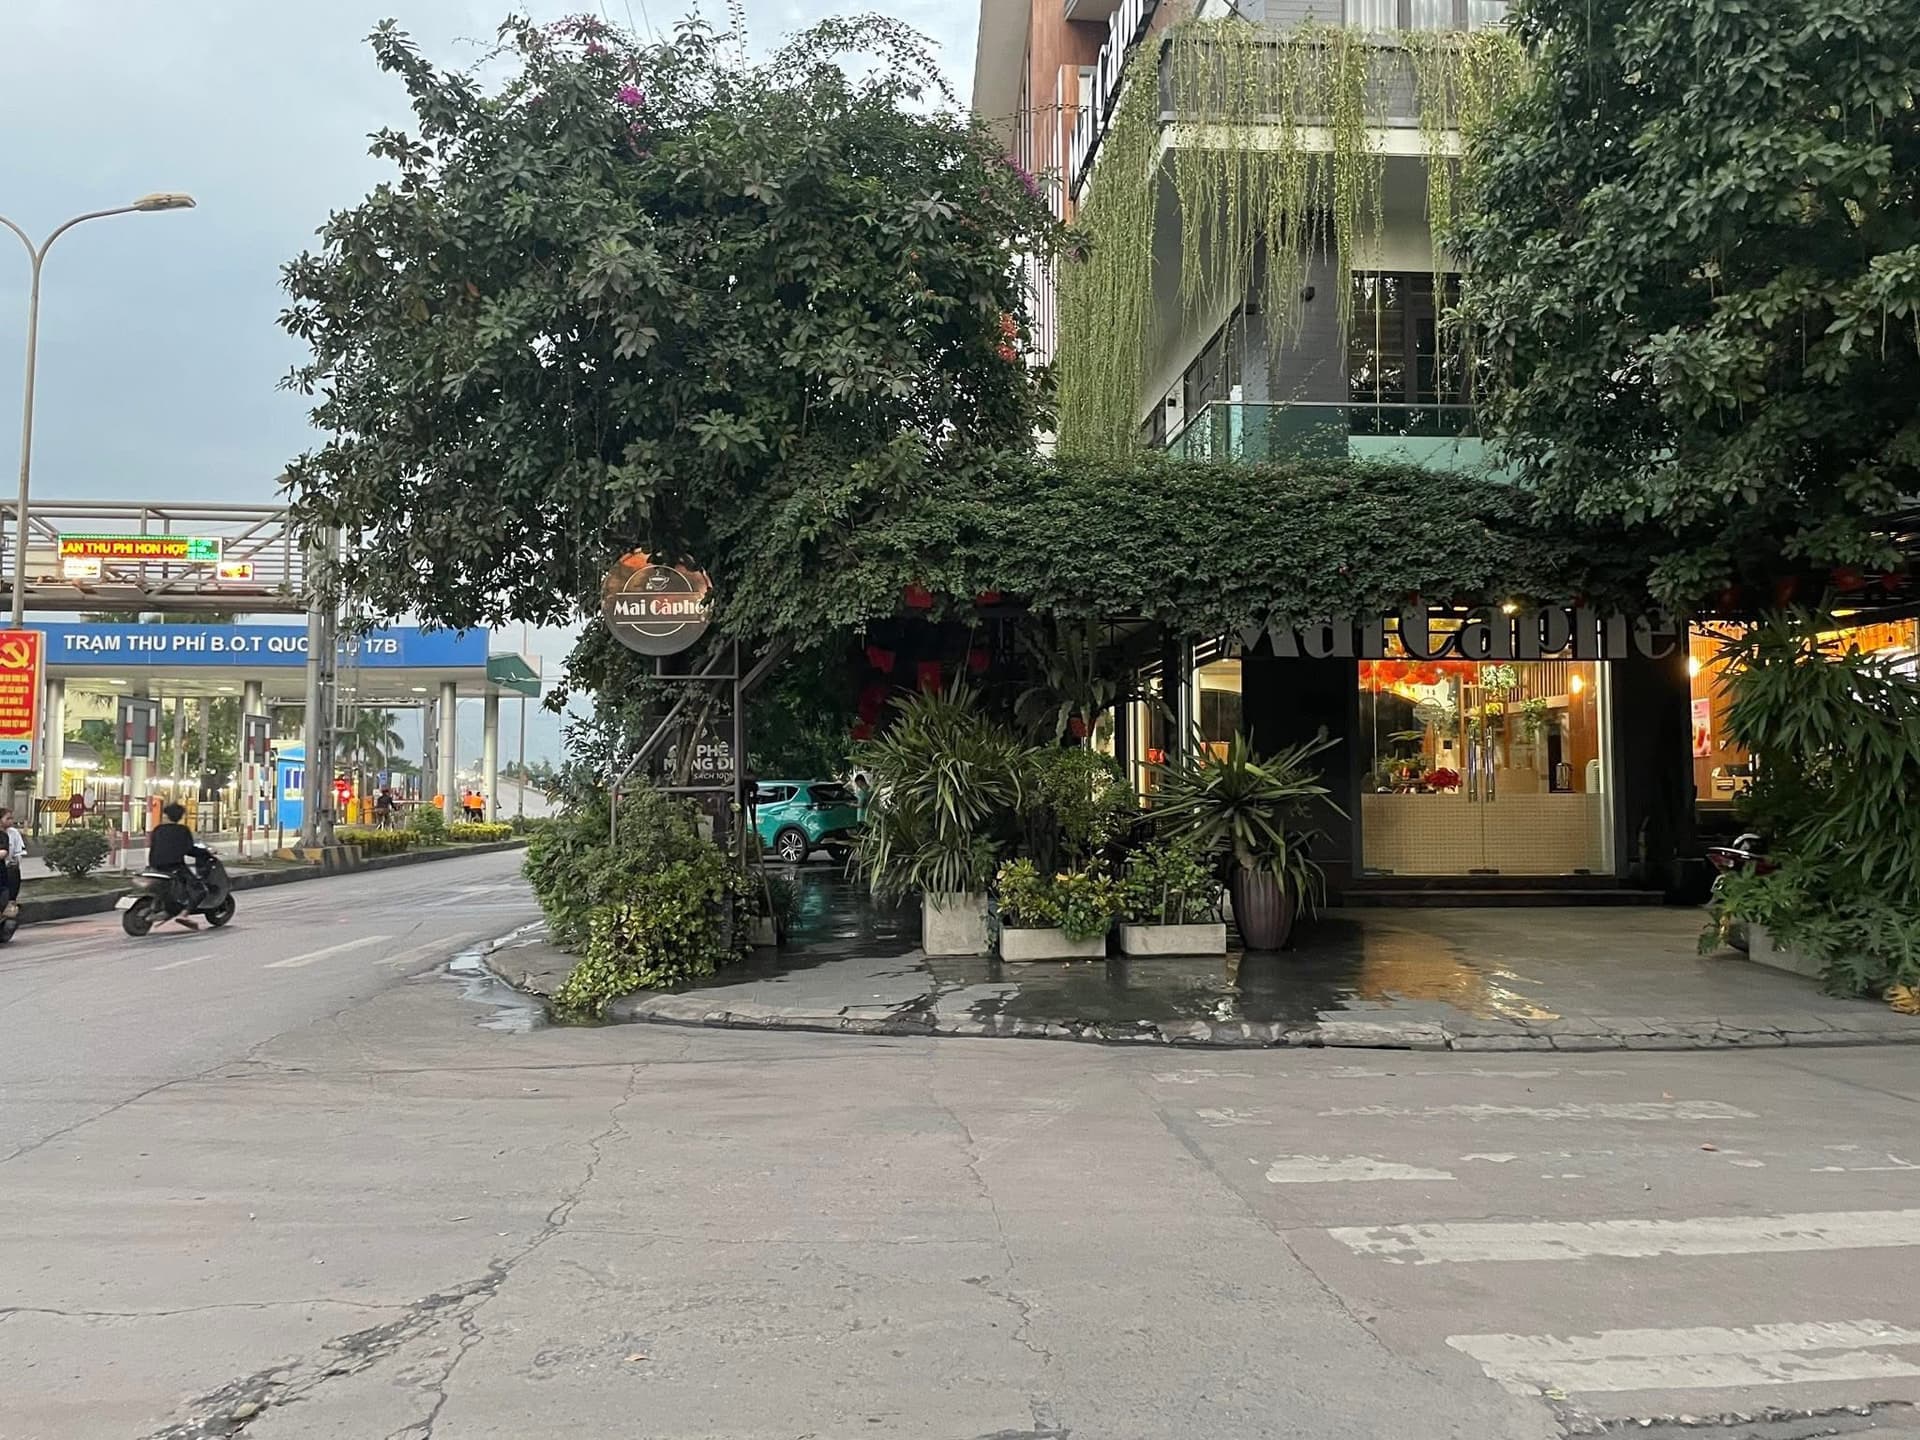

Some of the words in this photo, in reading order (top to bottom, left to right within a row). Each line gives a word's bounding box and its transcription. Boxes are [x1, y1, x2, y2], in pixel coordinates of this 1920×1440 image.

[86, 543, 111, 554] THU
[614, 599, 646, 616] Mai
[64, 635, 121, 655] TRẠM
[126, 636, 167, 651] THU
[172, 632, 207, 651] PHÍ
[211, 636, 263, 652] B.O.T
[365, 638, 398, 654] 17B
[696, 741, 729, 757] PHÊ
[663, 757, 713, 771] MNG
